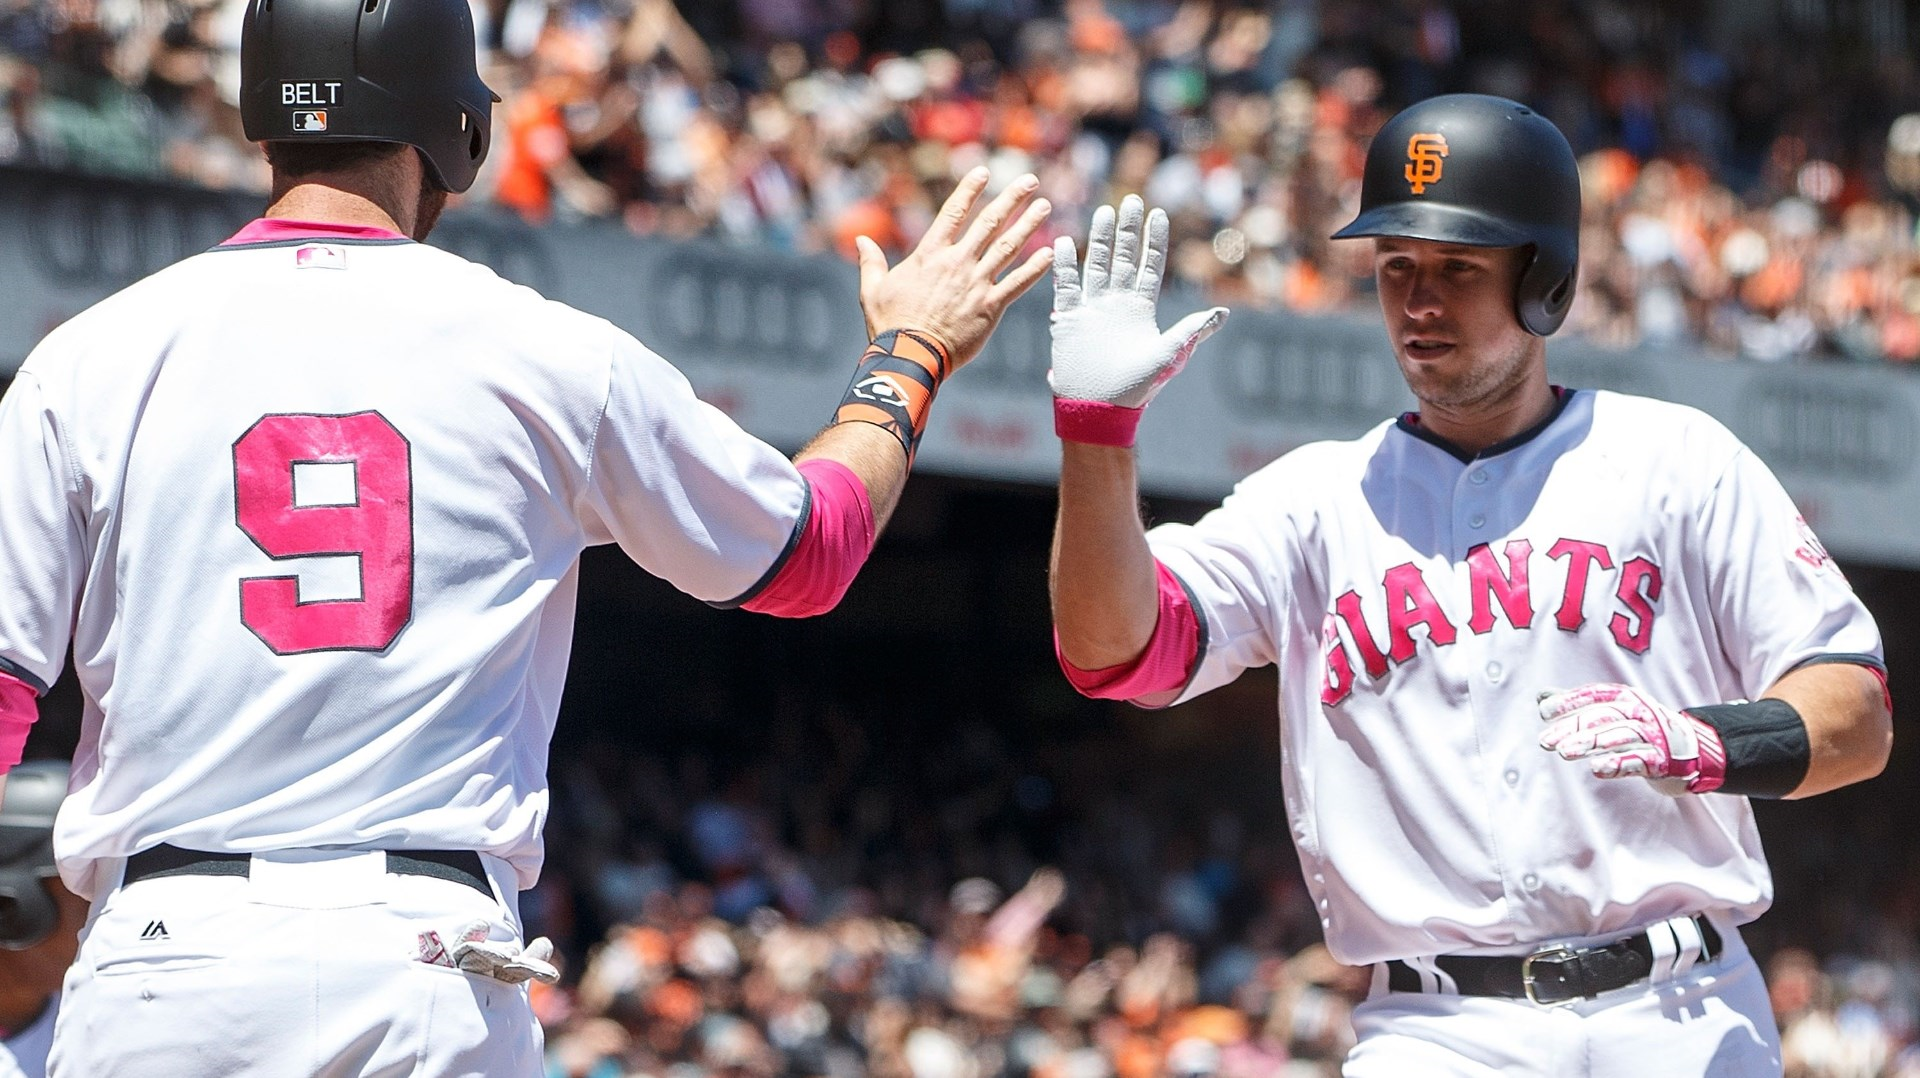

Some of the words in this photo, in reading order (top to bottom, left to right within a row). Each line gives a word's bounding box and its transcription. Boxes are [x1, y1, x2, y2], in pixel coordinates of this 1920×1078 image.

[281, 82, 342, 105] BELT
[1404, 133, 1449, 195] SF
[231, 409, 415, 656] 9
[1320, 537, 1664, 708] GIANTS
